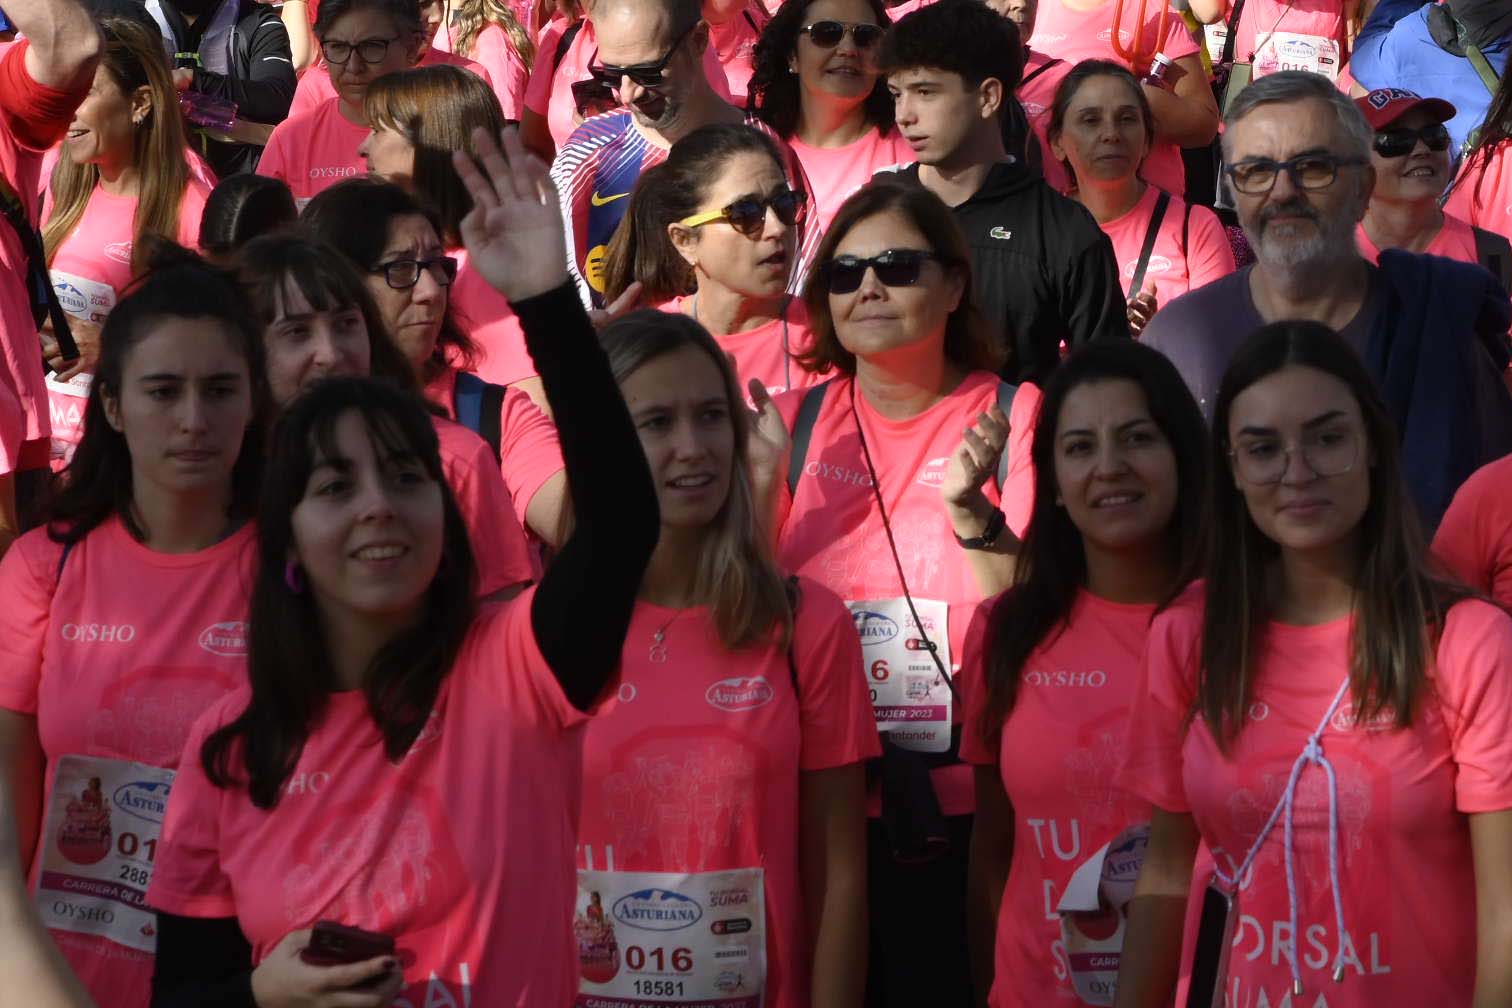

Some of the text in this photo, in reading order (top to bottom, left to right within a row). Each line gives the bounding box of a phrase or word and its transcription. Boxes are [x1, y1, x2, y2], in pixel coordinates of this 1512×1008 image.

[309, 164, 358, 179] OYSHO
[61, 623, 135, 643] OYSHO
[890, 729, 937, 741] antander
[120, 790, 165, 813] ASTUR
[116, 832, 157, 862] 01
[1027, 818, 1080, 861] TU
[119, 865, 149, 887] 288
[710, 895, 749, 908] SUMA
[53, 899, 115, 925] OYSHO
[619, 903, 696, 922] ASTURIANA
[625, 945, 694, 972] 016
[1090, 957, 1119, 967] CARR
[633, 980, 685, 997] 18581
